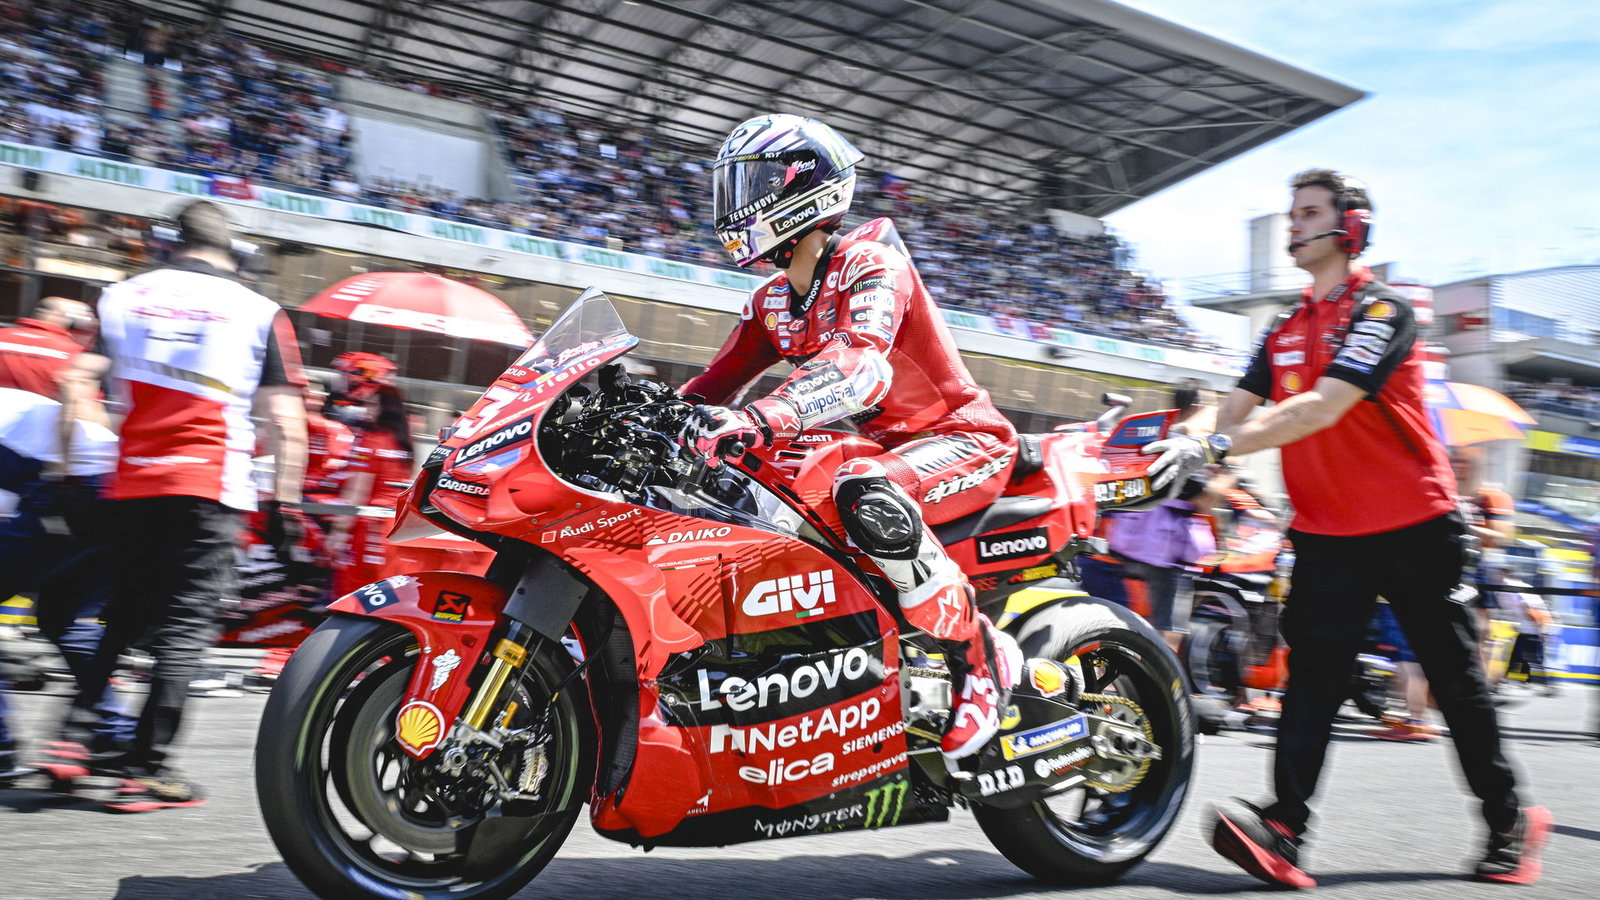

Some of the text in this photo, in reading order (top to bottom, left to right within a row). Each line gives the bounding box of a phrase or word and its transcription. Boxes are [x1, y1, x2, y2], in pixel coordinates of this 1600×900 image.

[729, 193, 778, 223] TERRANOVA
[775, 205, 816, 232] Lenovo
[801, 279, 821, 312] Lenovo
[504, 367, 527, 378] OUP
[536, 358, 601, 393] riello
[788, 370, 839, 395] Lenovo
[455, 421, 532, 463] Lenovo
[437, 478, 490, 495] CARRERA
[924, 451, 1013, 504] alpinestars
[559, 508, 642, 539] Audi Sport
[666, 526, 732, 545] DAIKO
[979, 534, 1048, 558] Lenovo
[742, 569, 837, 617] GIVI
[697, 647, 868, 712] Lenovo
[748, 697, 881, 754] NetApp
[842, 720, 906, 756] SIEMENS
[738, 752, 835, 786] elica
[832, 752, 907, 787] streparava
[754, 804, 863, 838] MONSTER
